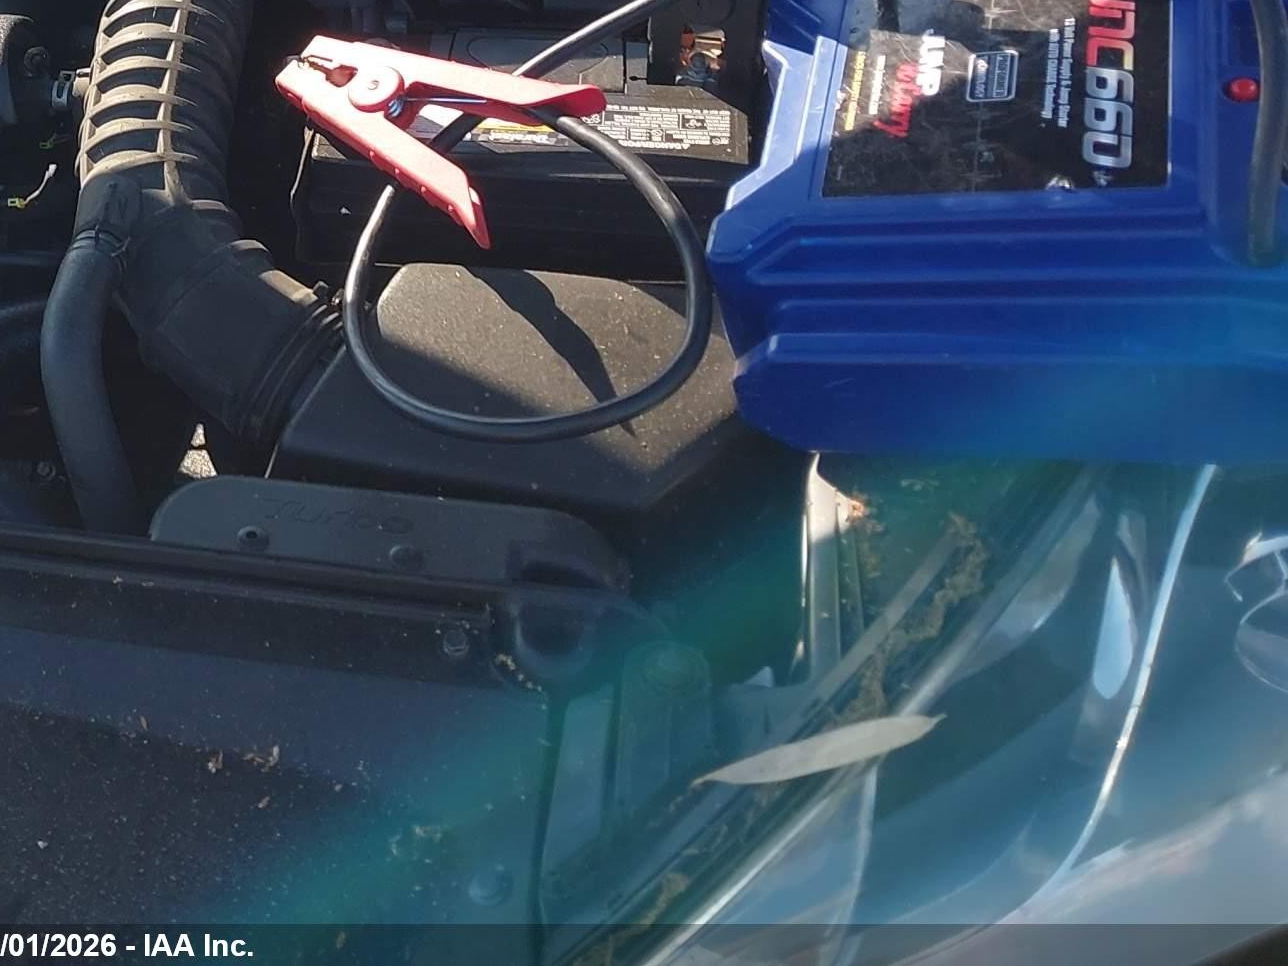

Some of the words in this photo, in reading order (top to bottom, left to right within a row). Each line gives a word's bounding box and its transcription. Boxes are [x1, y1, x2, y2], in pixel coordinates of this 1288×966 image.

[1063, 39, 1074, 57] Power
[916, 29, 945, 96] JUMP
[1059, 58, 1073, 79] Supply
[1057, 87, 1071, 104] Jump
